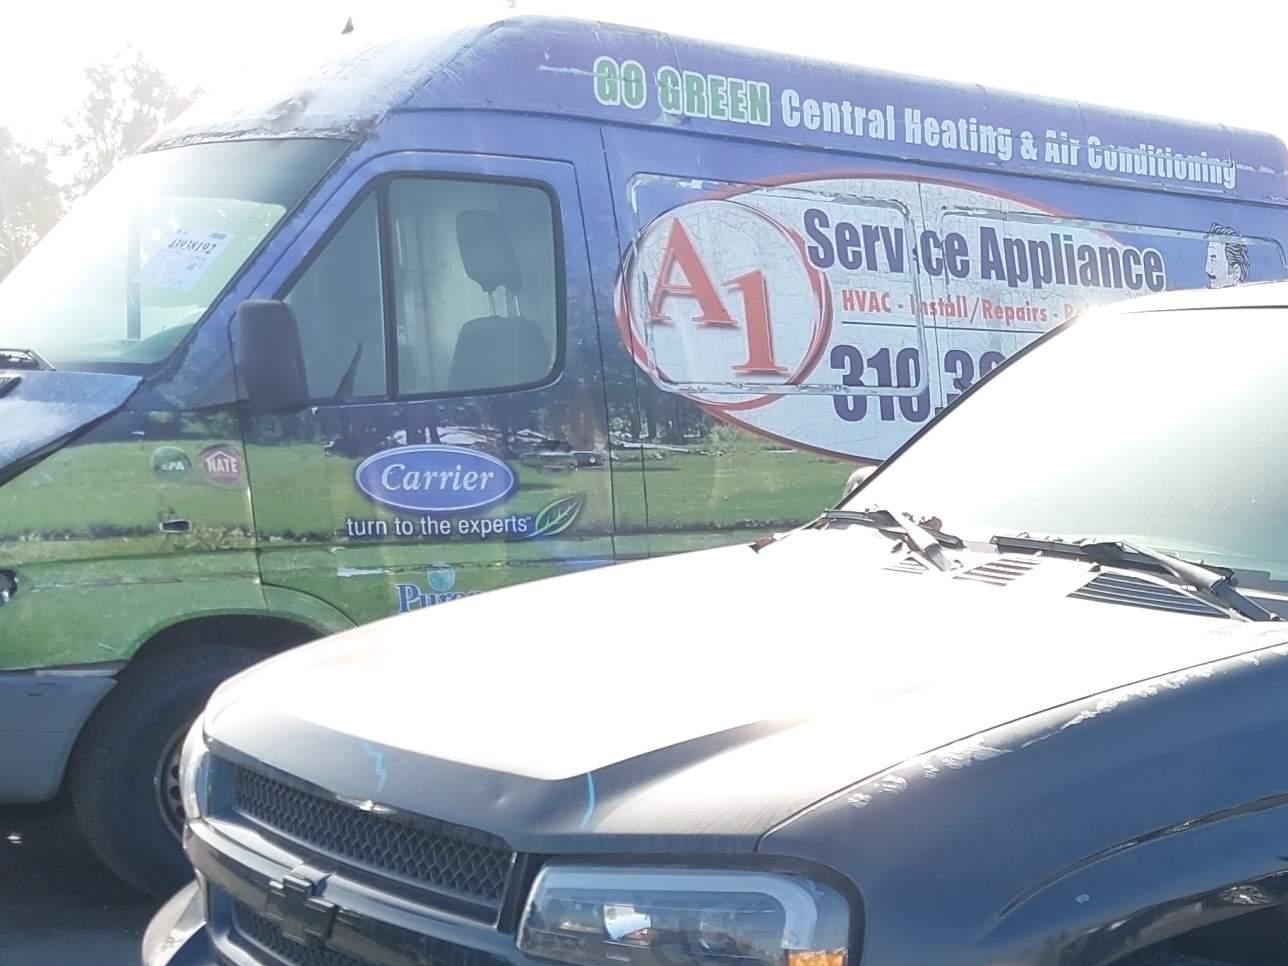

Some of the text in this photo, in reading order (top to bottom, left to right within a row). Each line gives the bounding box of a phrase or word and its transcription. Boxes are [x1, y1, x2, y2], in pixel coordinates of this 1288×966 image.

[593, 56, 1235, 189] GO GREEN Central Heating & Air Conditioning
[804, 208, 1165, 292] Servce Appliance
[842, 290, 891, 313] HVAC
[207, 458, 239, 473] NATE
[381, 463, 494, 491] Carrier
[347, 518, 387, 536] turn
[395, 517, 413, 536] to
[421, 516, 450, 535] the
